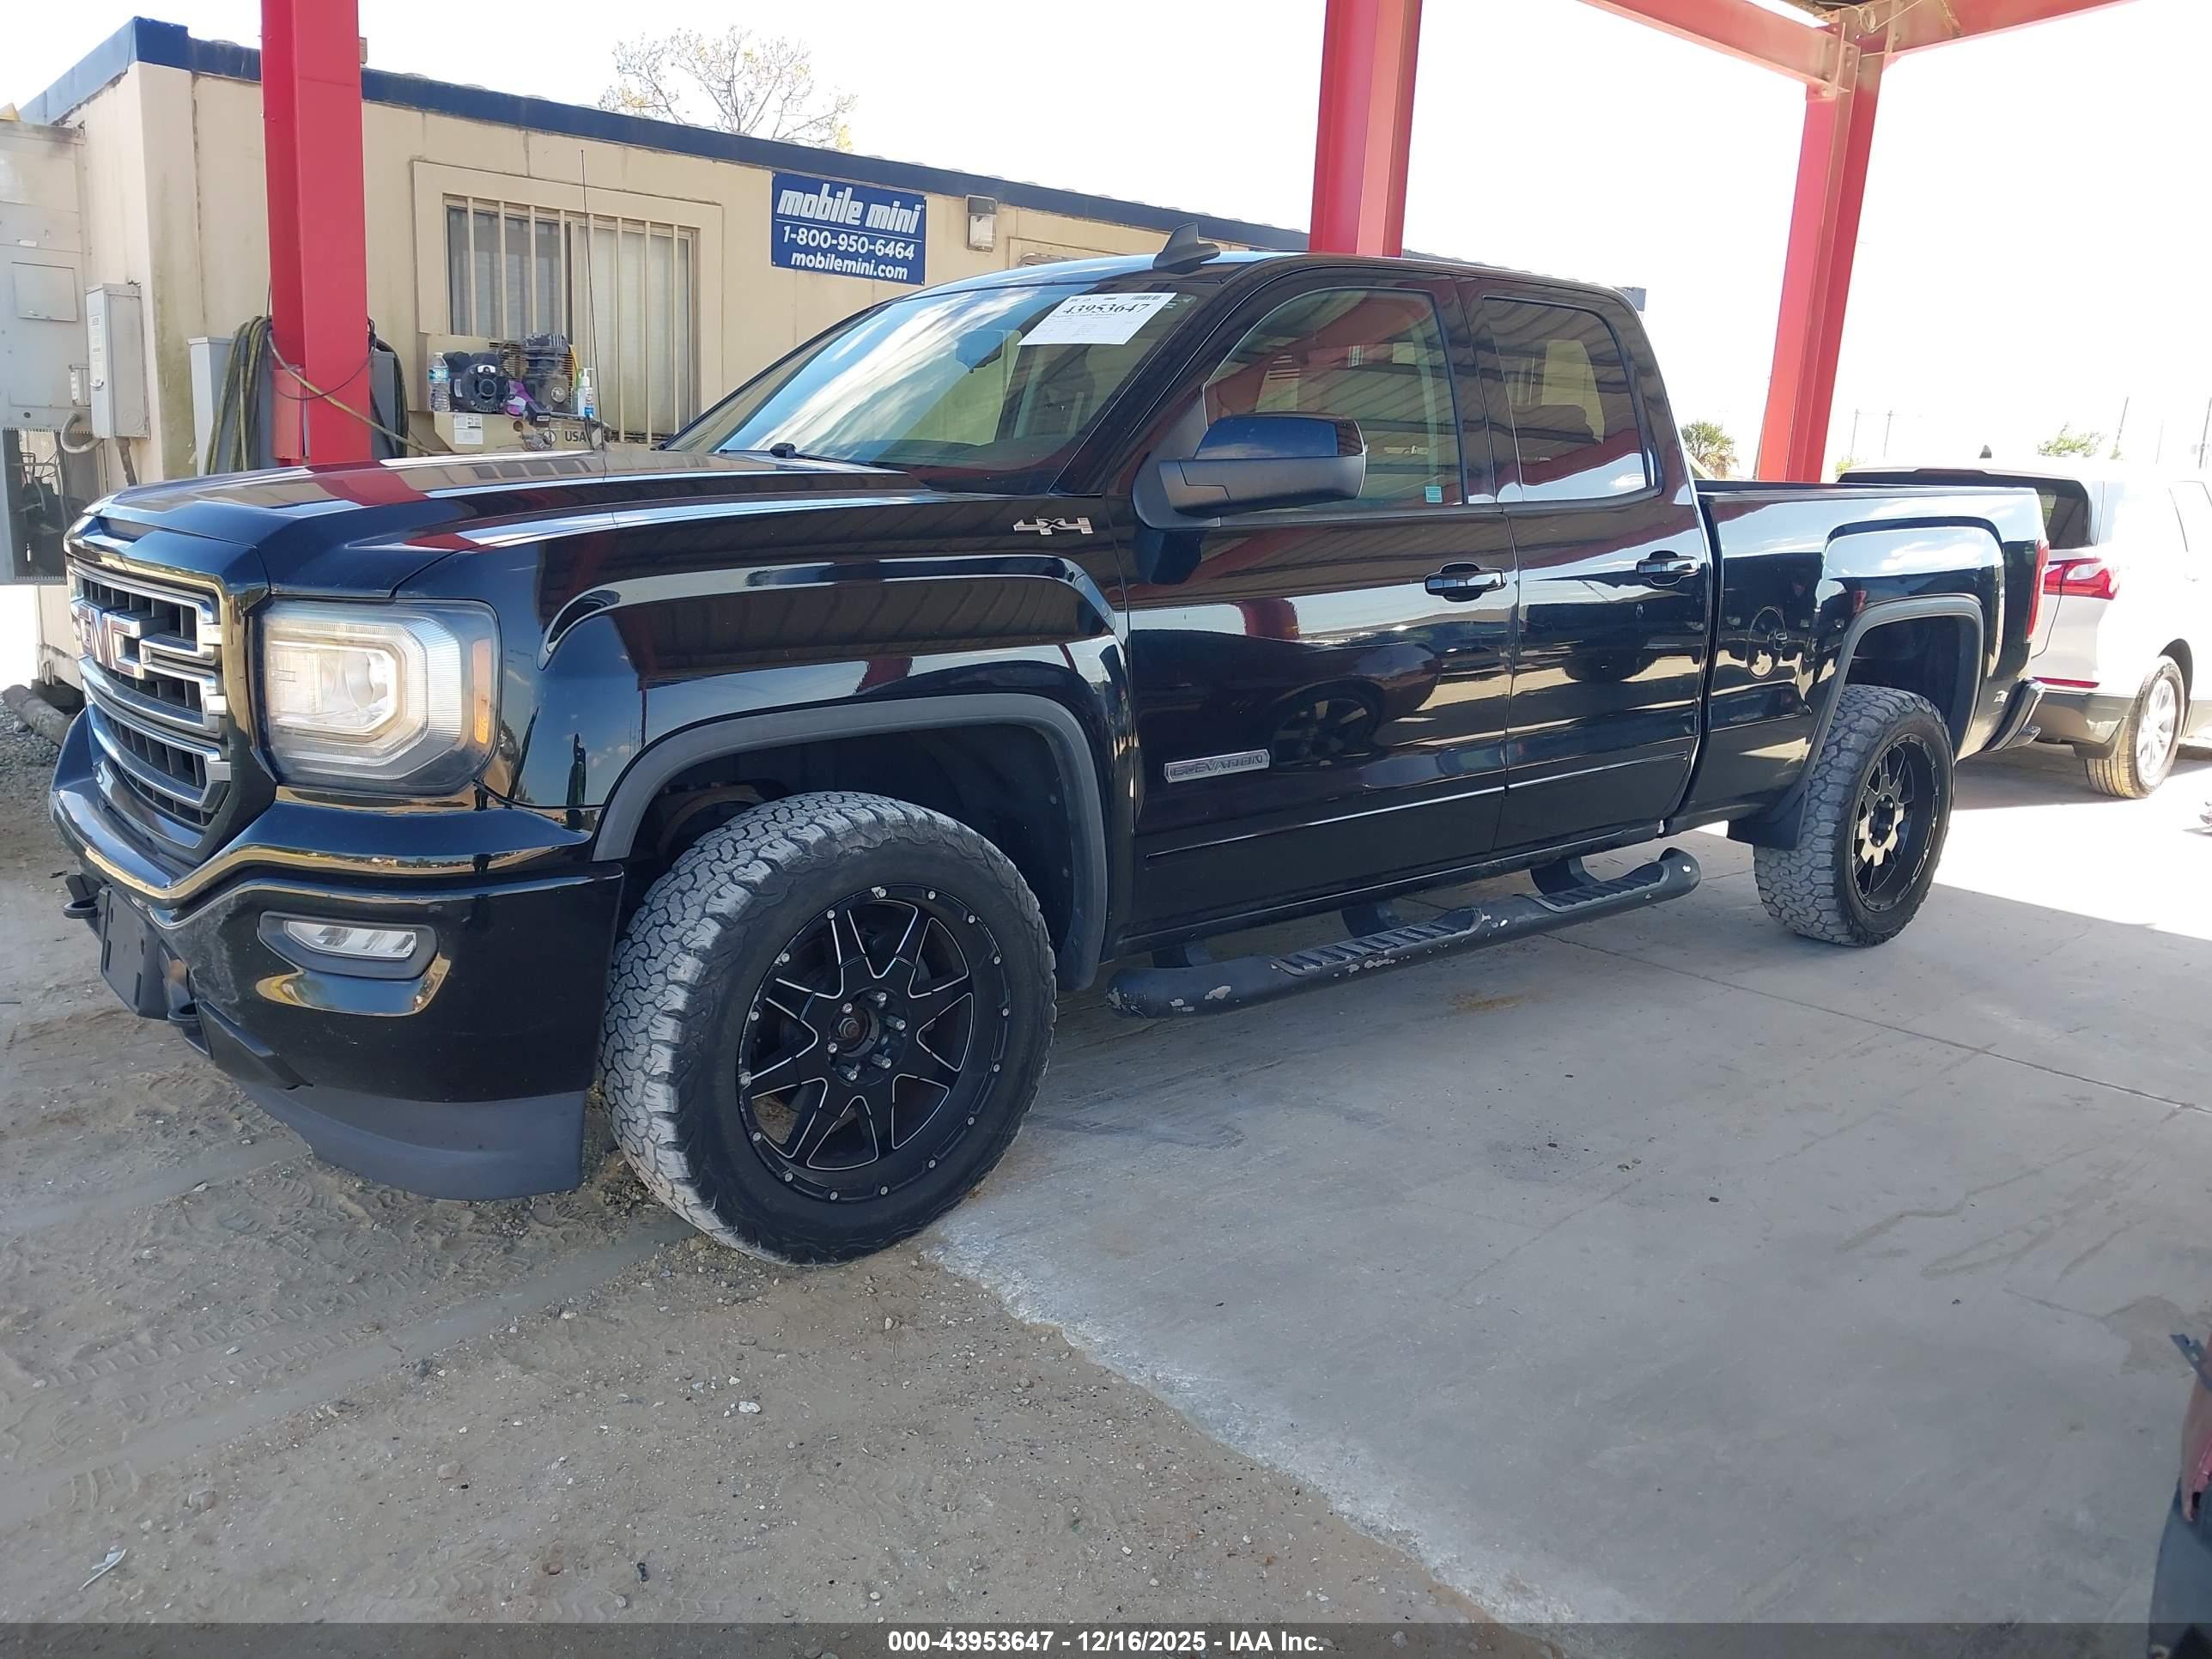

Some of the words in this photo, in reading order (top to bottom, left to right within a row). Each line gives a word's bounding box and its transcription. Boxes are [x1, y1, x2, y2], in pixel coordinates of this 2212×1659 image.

[776, 183, 864, 225] mobile
[865, 200, 921, 234] mini
[783, 225, 915, 261] 1-800-950-6464
[790, 252, 908, 281] mobilemini.com
[1062, 302, 1152, 314] 43953647
[564, 430, 586, 442] USA
[77, 603, 144, 680] GMC
[1173, 754, 1263, 778] ELEVATION
